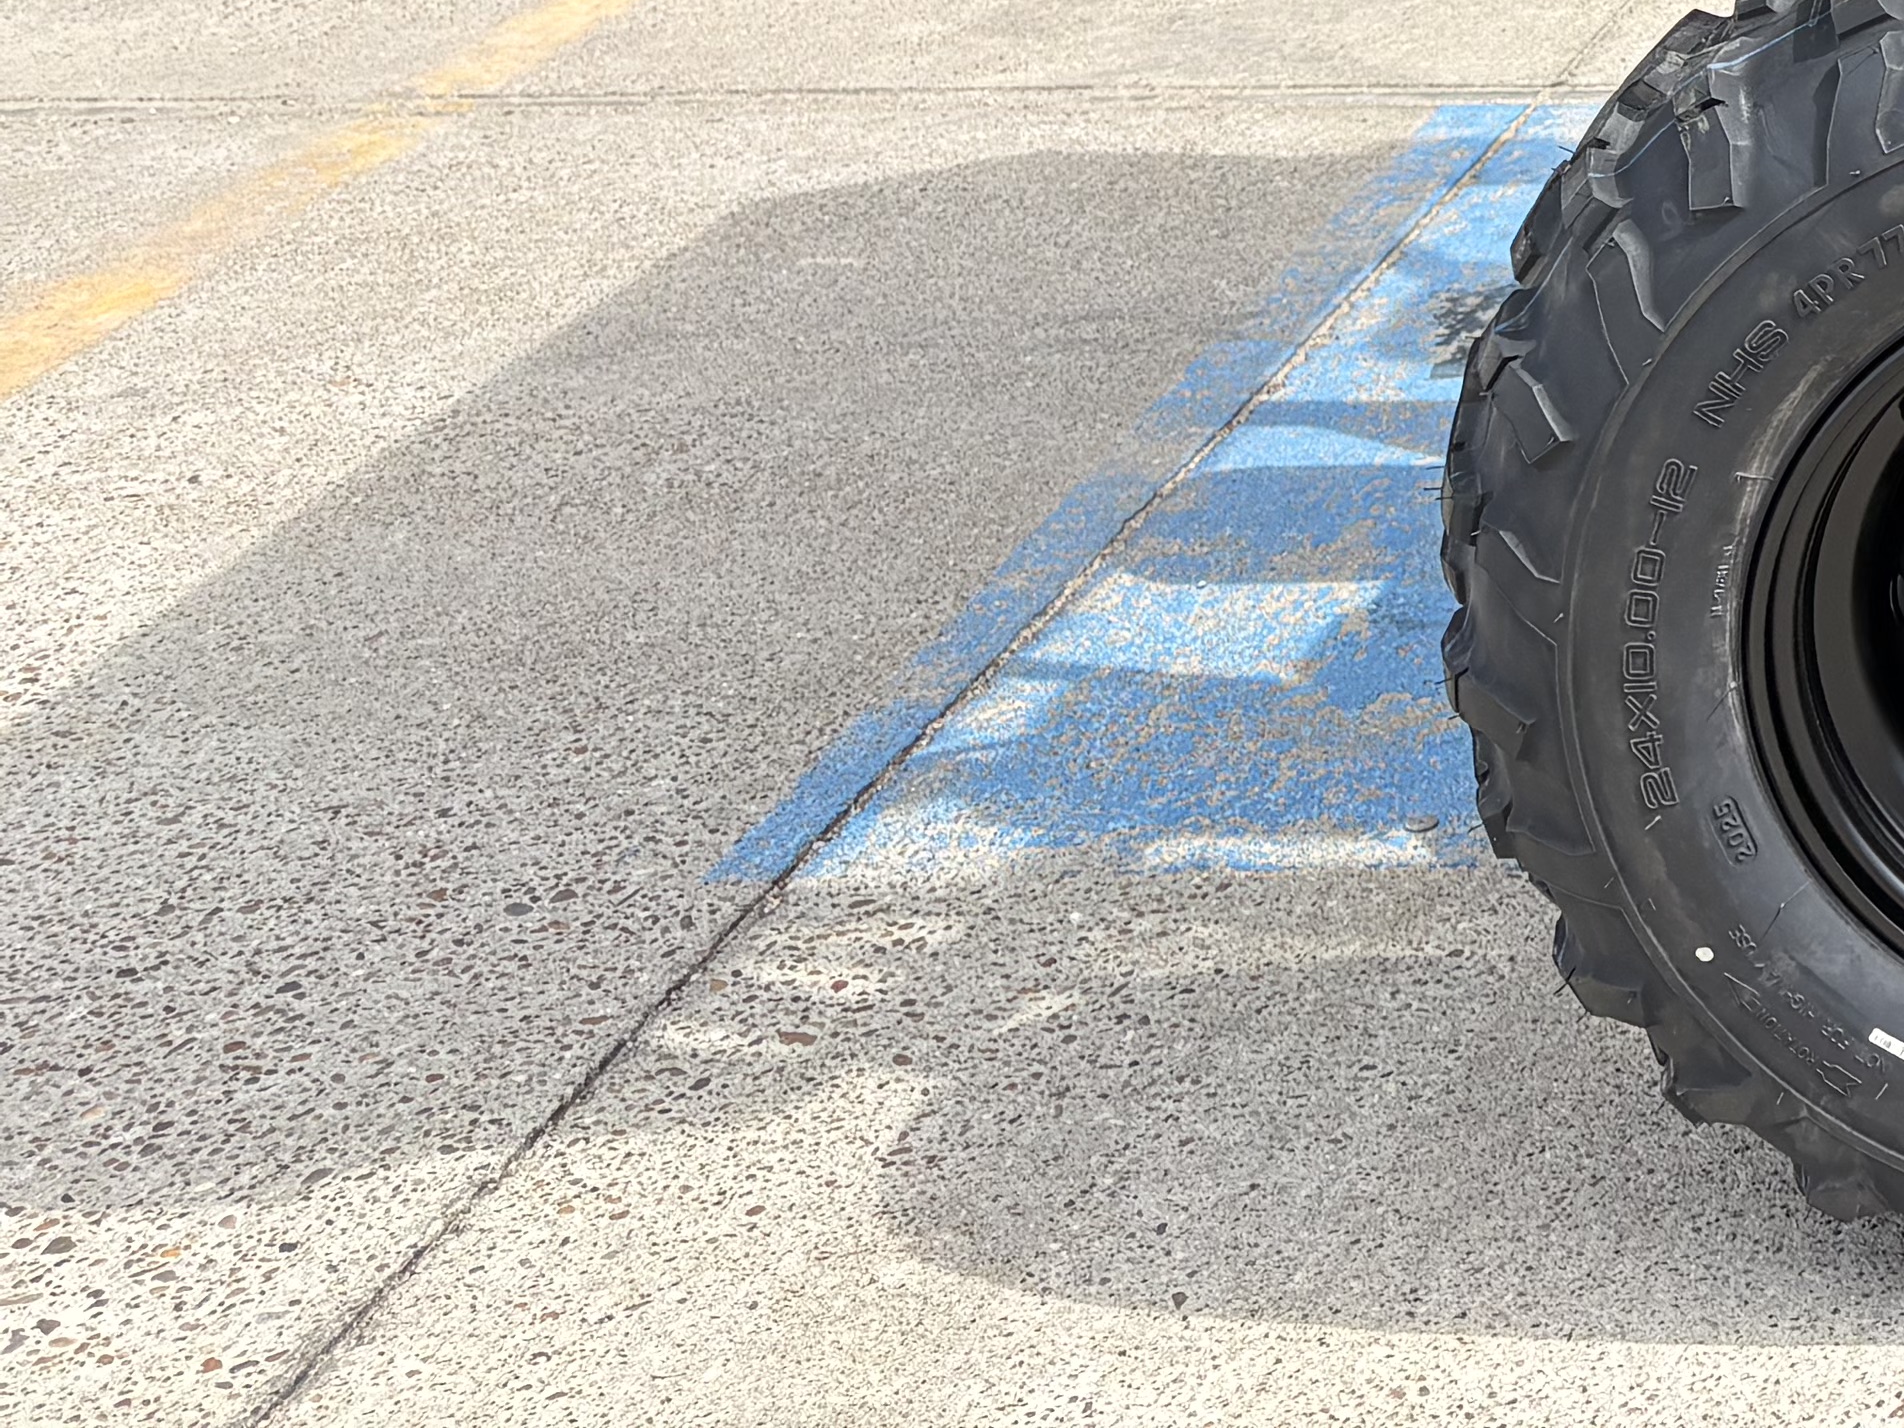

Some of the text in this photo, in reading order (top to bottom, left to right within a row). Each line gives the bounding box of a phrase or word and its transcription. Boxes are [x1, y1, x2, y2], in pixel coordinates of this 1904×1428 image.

[1692, 318, 1791, 429] NHS
[1792, 255, 1866, 318] 4PR
[1712, 797, 1756, 866] 2025
[1755, 1006, 1821, 1066] ROTATION
